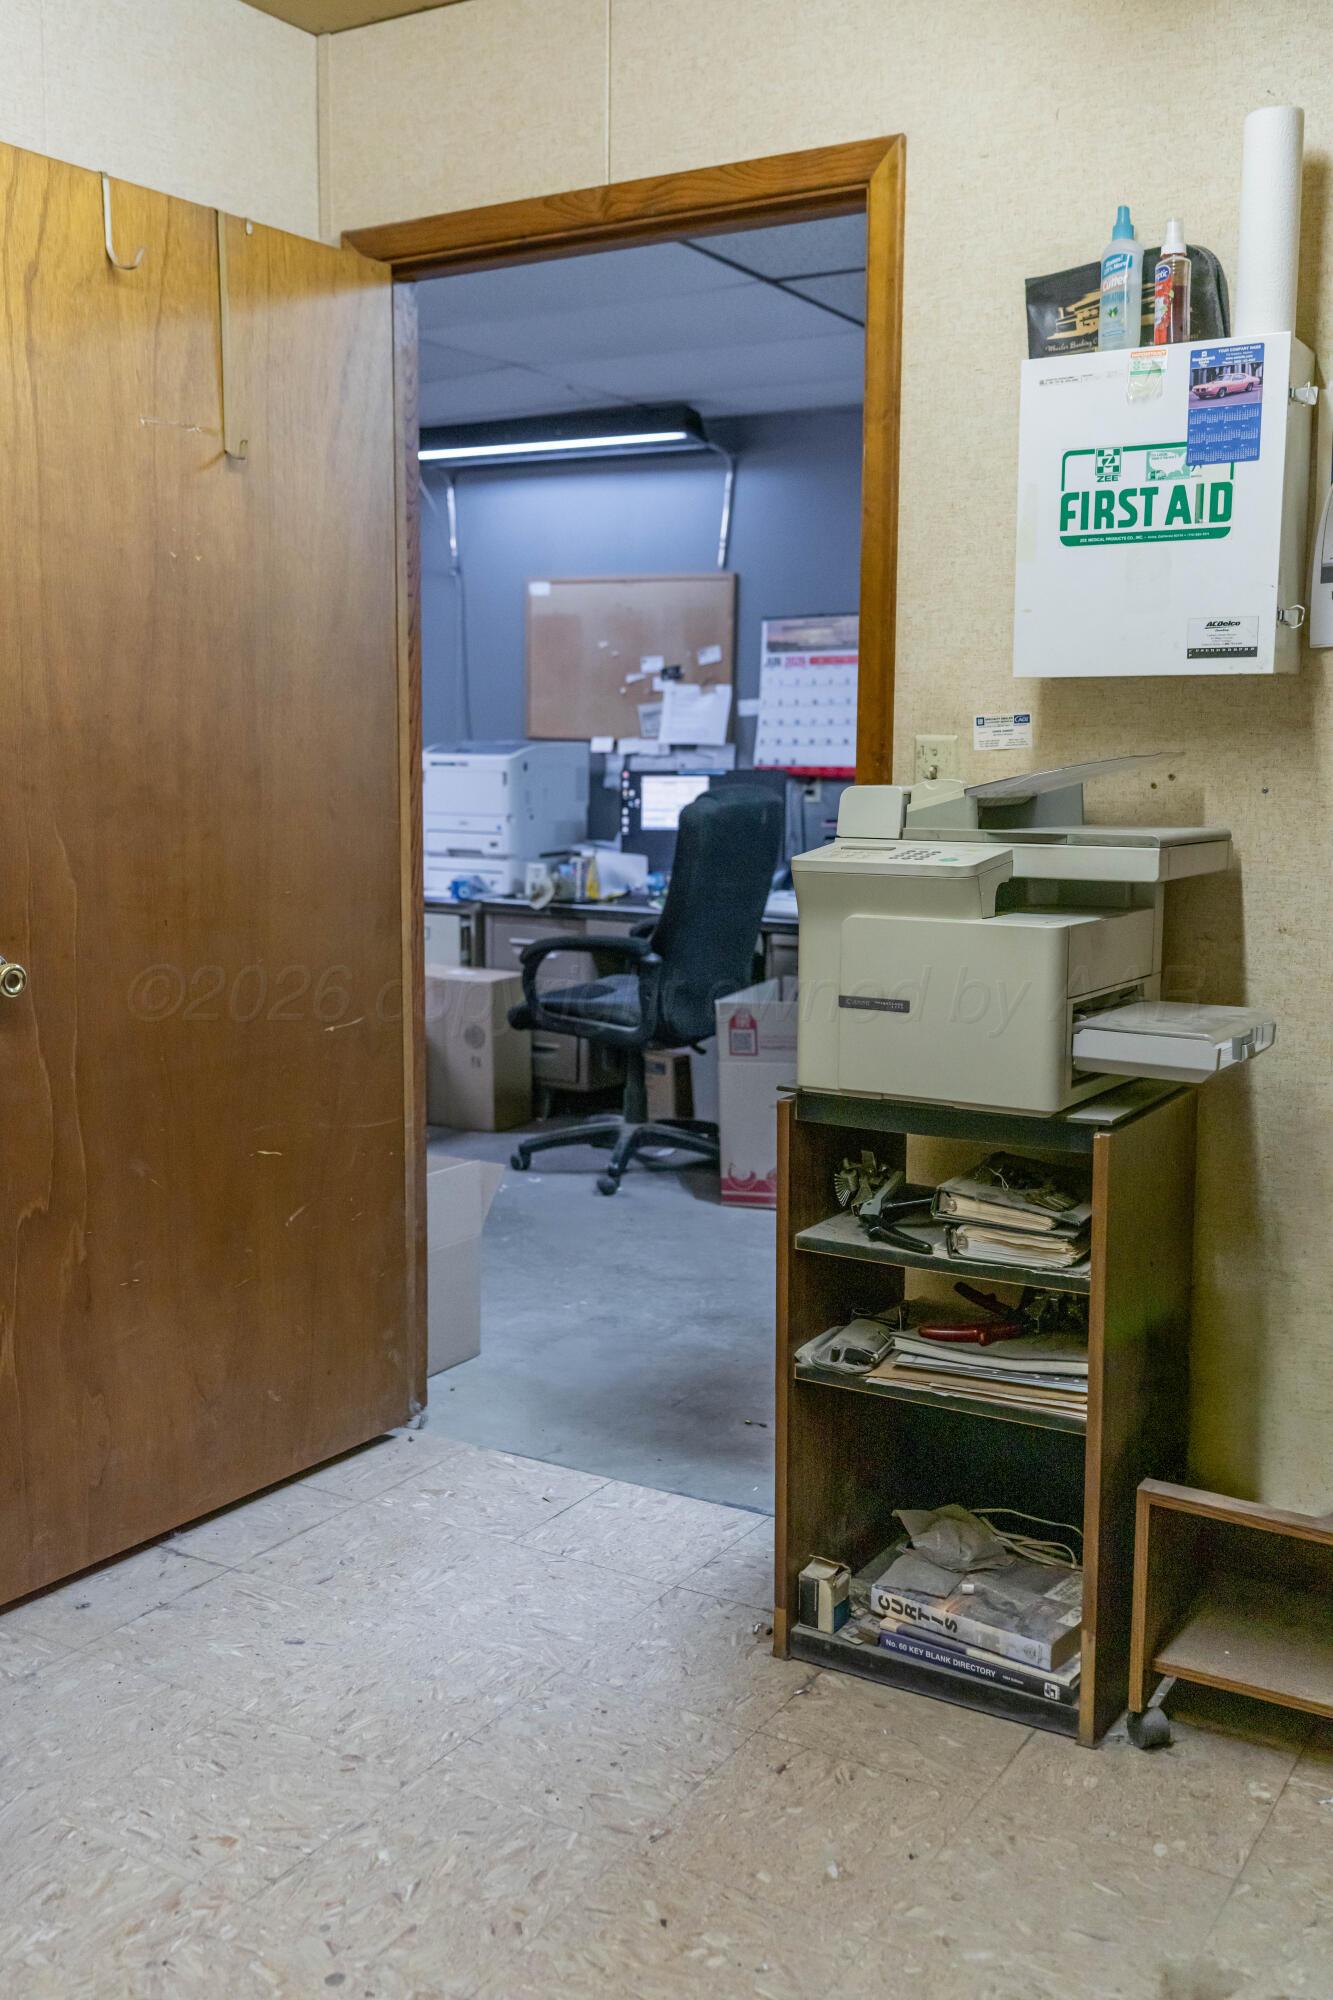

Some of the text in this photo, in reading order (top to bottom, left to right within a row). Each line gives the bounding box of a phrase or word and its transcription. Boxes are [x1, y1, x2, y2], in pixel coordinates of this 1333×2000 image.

[1096, 474, 1119, 483] ZEE
[1059, 481, 1233, 532] FIRST AID
[877, 1594, 959, 1635] CURTIS
[885, 1638, 897, 1649] No.
[908, 1645, 924, 1657] KEY
[925, 1649, 951, 1665] BLANK
[952, 1658, 997, 1678] DIRECTORY
